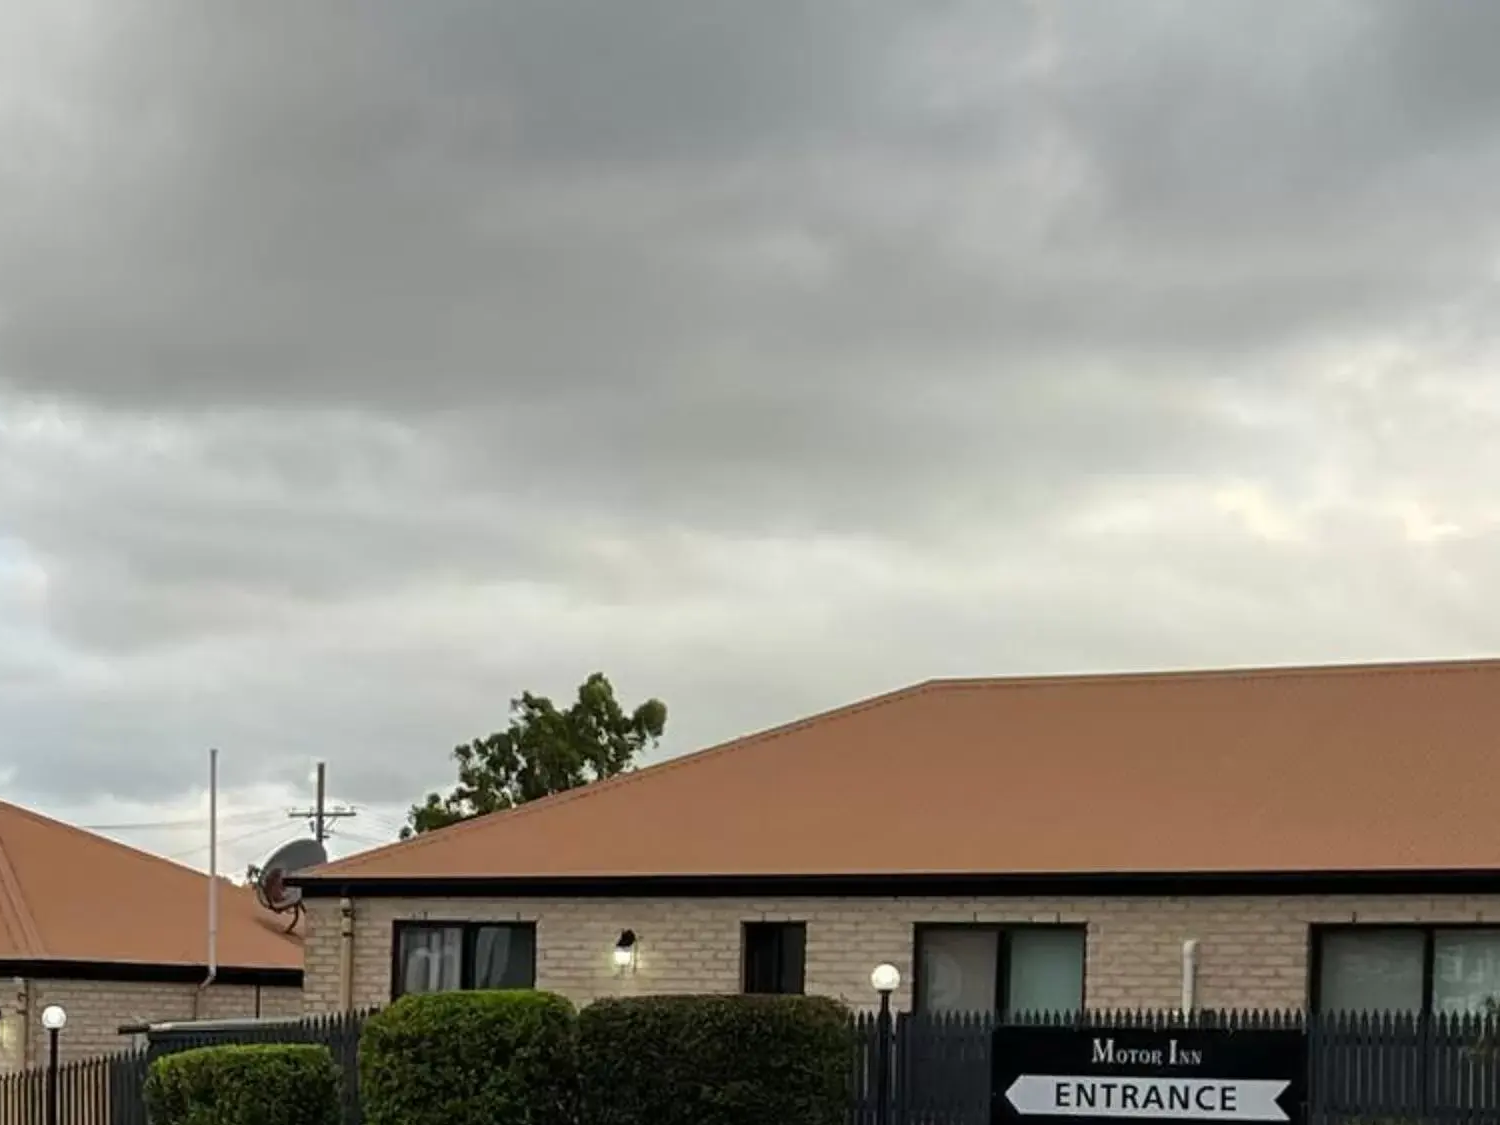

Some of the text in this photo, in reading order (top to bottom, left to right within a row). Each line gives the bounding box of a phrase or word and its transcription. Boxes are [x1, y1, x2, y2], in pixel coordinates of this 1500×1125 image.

[1092, 1038, 1202, 1065] MOTOR INN
[1055, 1082, 1238, 1112] ENTRANCE
